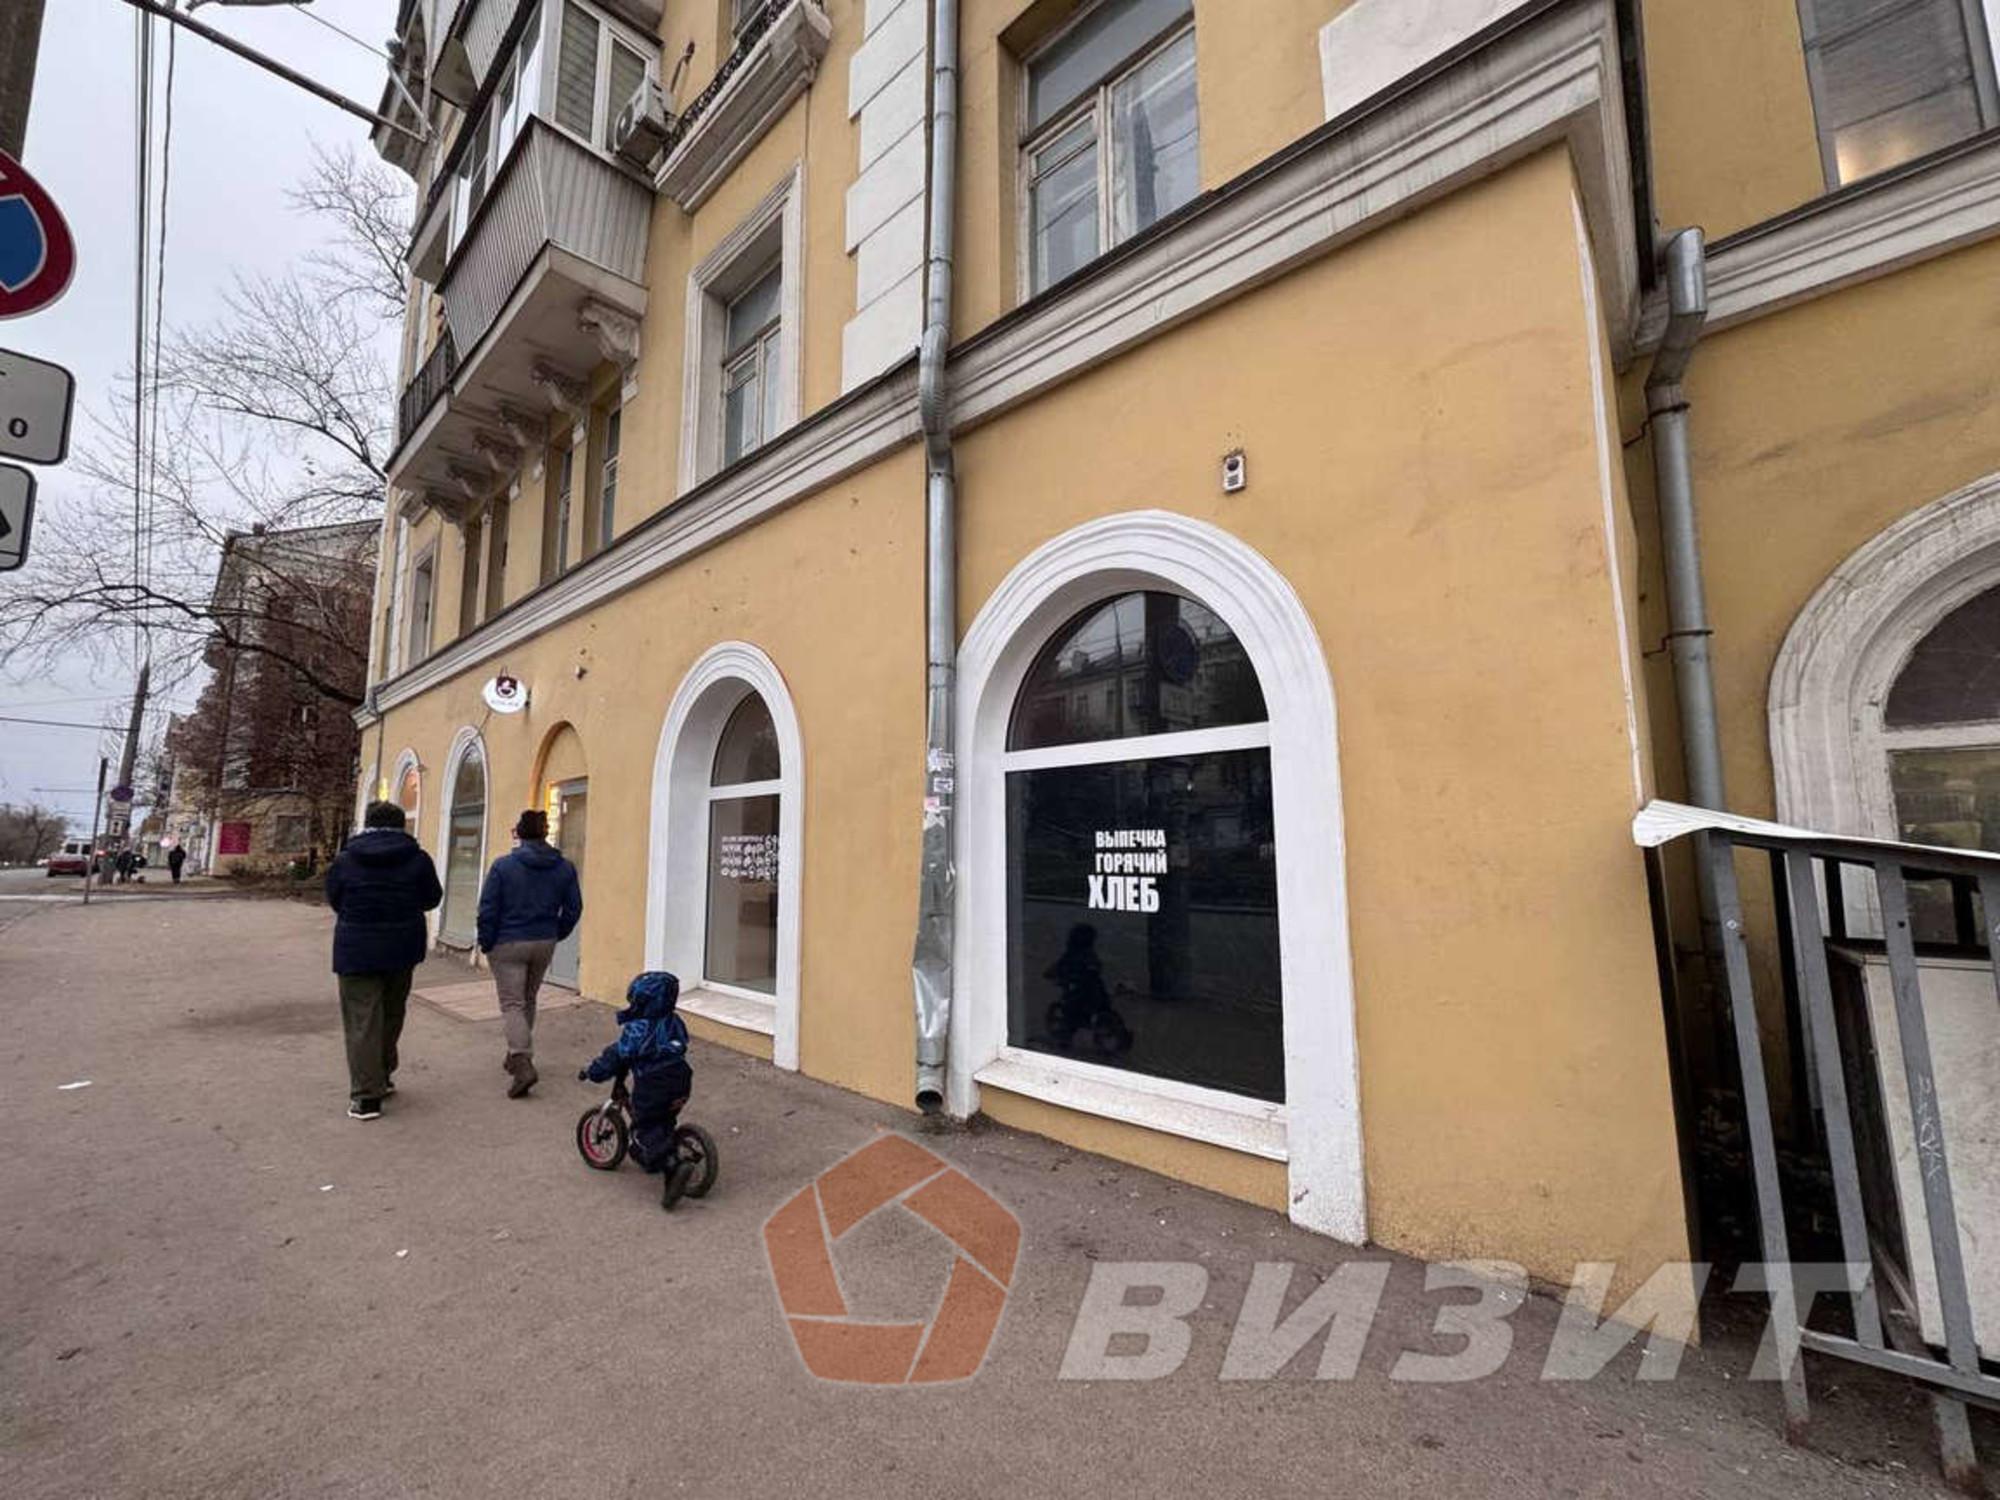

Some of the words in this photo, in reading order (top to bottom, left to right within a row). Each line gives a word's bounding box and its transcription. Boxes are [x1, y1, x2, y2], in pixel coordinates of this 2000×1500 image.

[1095, 830, 1167, 848] ВЫПЕЧКА
[1096, 850, 1168, 874] ГОРЯЧИЙ
[1088, 875, 1160, 913] ХЛЕБ
